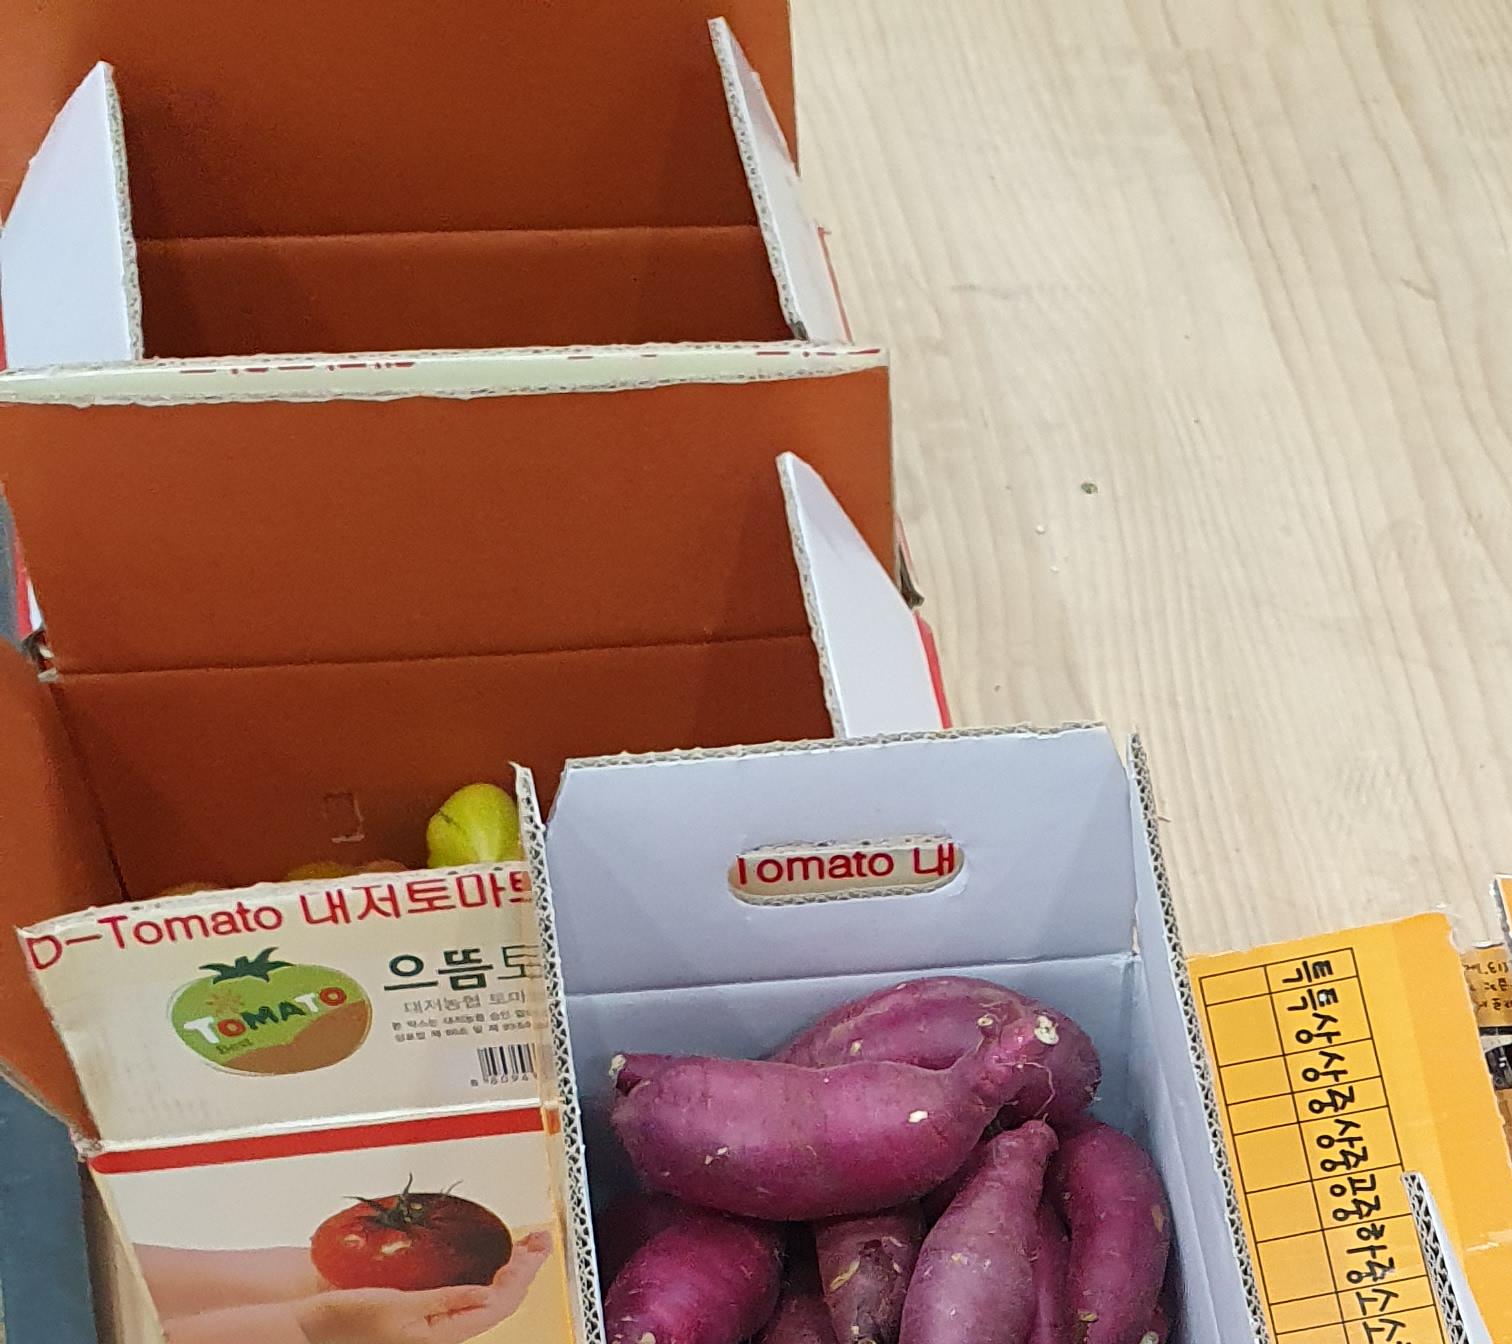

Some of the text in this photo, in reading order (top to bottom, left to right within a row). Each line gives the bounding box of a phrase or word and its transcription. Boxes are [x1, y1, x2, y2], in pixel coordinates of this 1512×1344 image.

[1281, 959, 1333, 984] 특
[183, 987, 347, 1044] TOMATO
[1286, 988, 1342, 1045] 특상
[1302, 1050, 1349, 1084] 상
[1308, 1085, 1355, 1114] 중
[1316, 1118, 1369, 1173] 상중
[1346, 1223, 1396, 1284] 하중
[1356, 1287, 1400, 1316] 소
